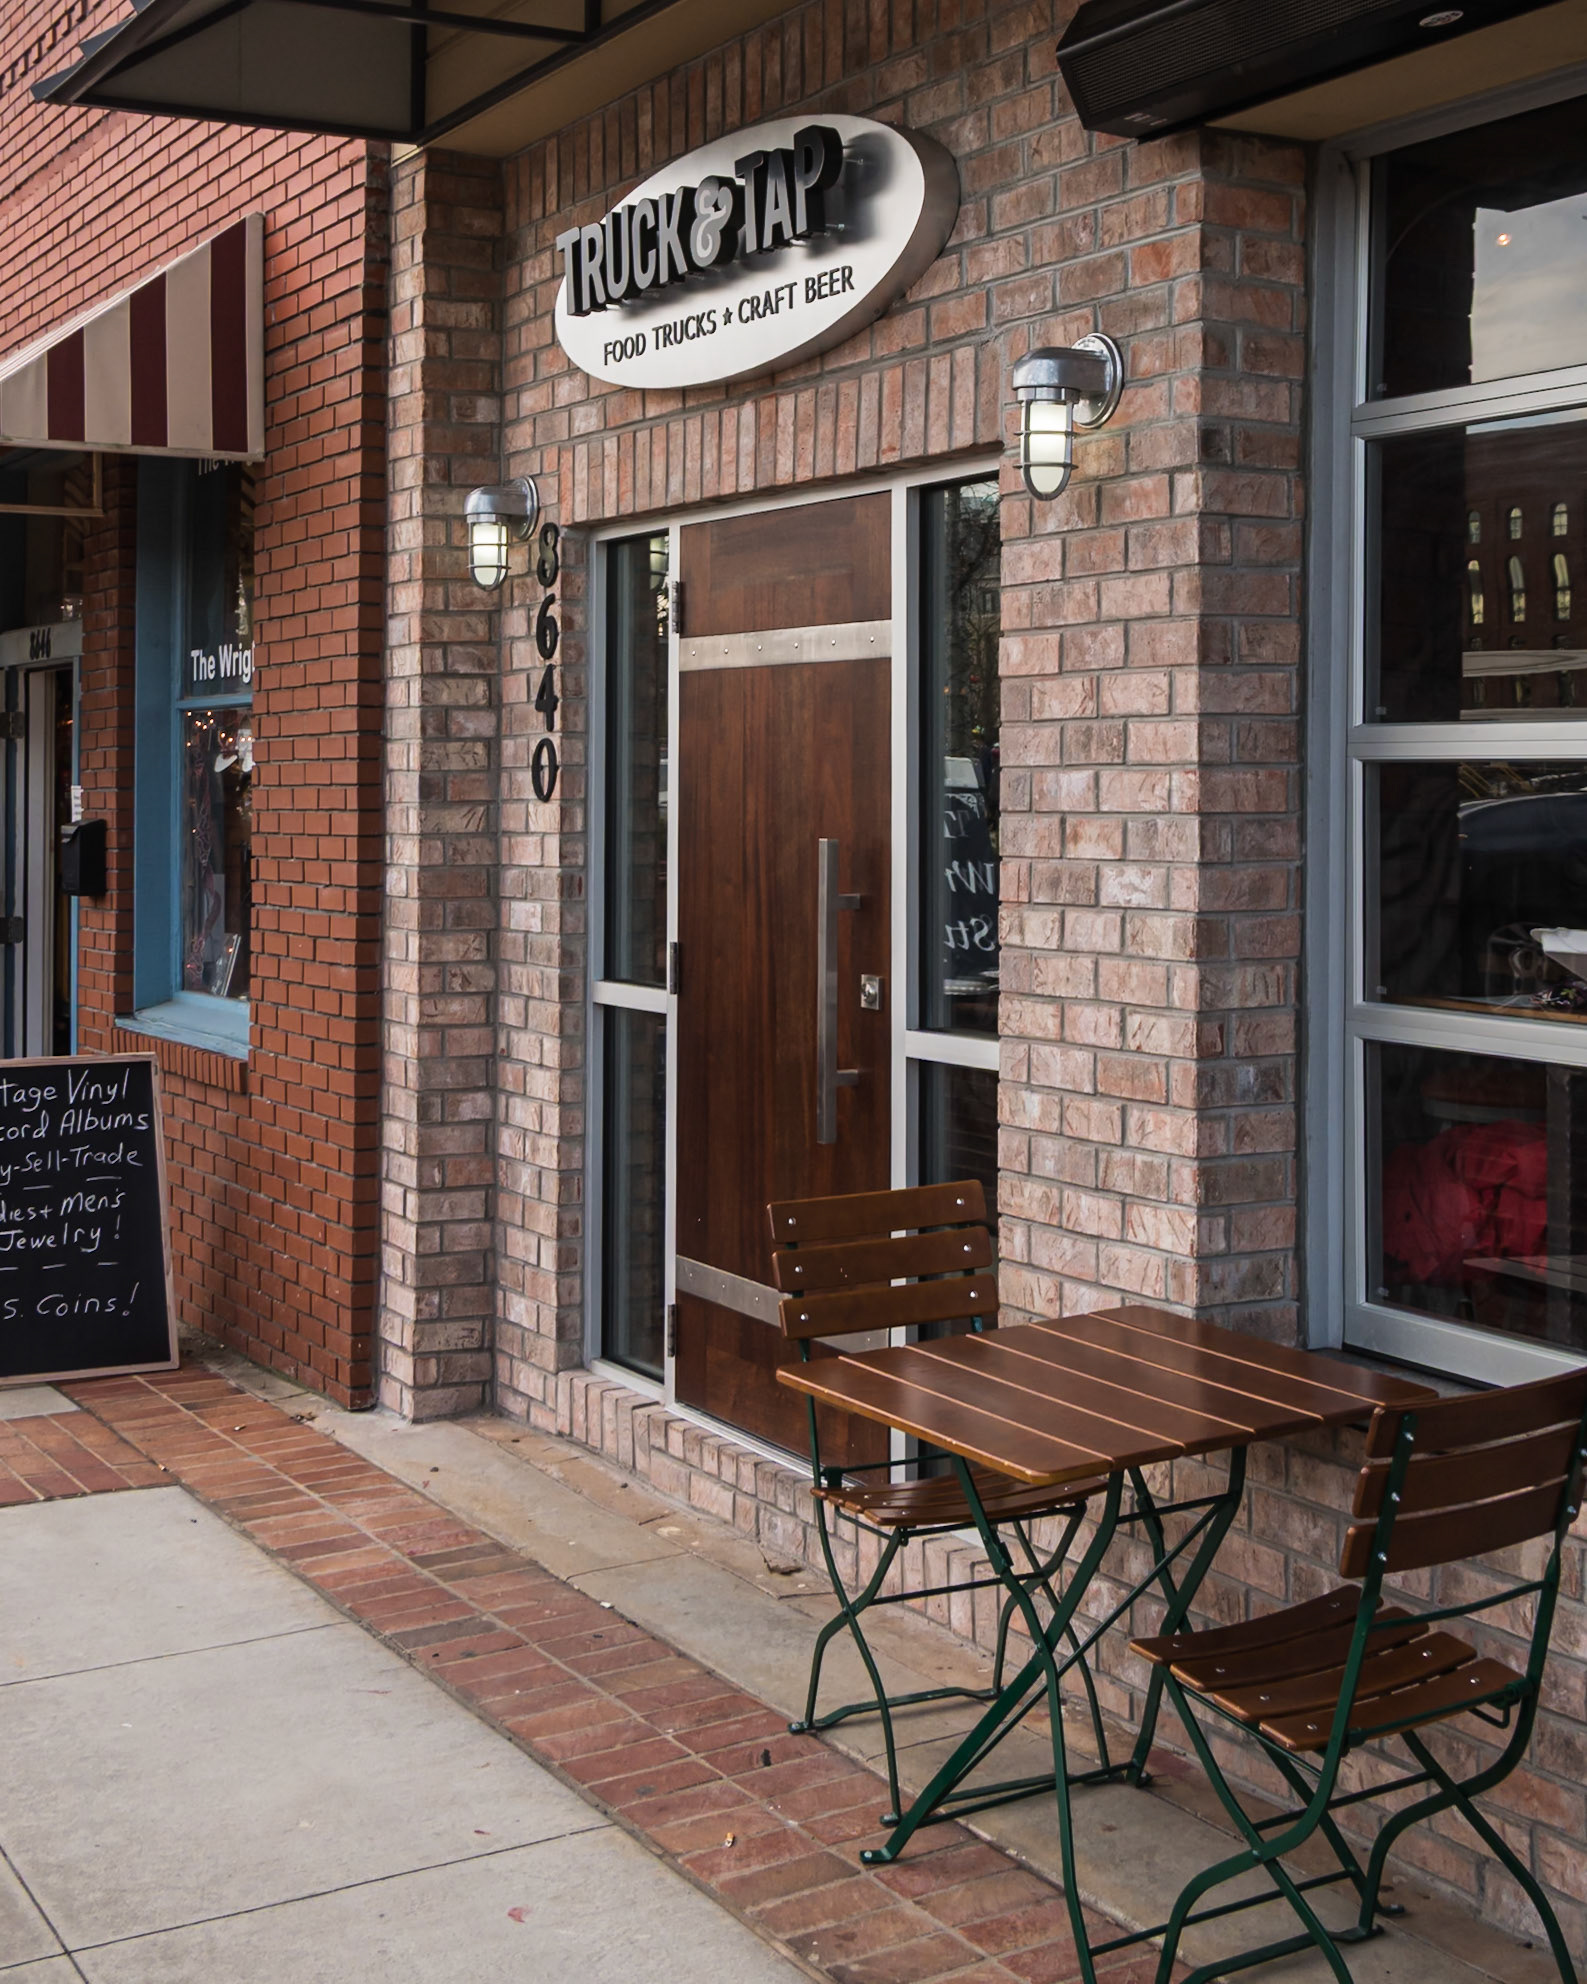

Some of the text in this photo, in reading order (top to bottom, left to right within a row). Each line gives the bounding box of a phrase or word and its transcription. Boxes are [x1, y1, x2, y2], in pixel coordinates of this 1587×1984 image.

[556, 186, 692, 317] TRUCK
[735, 124, 843, 255] TAP
[603, 265, 855, 366] FOOD TRUCKS CRAFT BEER
[191, 649, 216, 682] The
[531, 522, 559, 803] 8640
[67, 1068, 130, 1105] Vinyl
[59, 1109, 149, 1136] Albums
